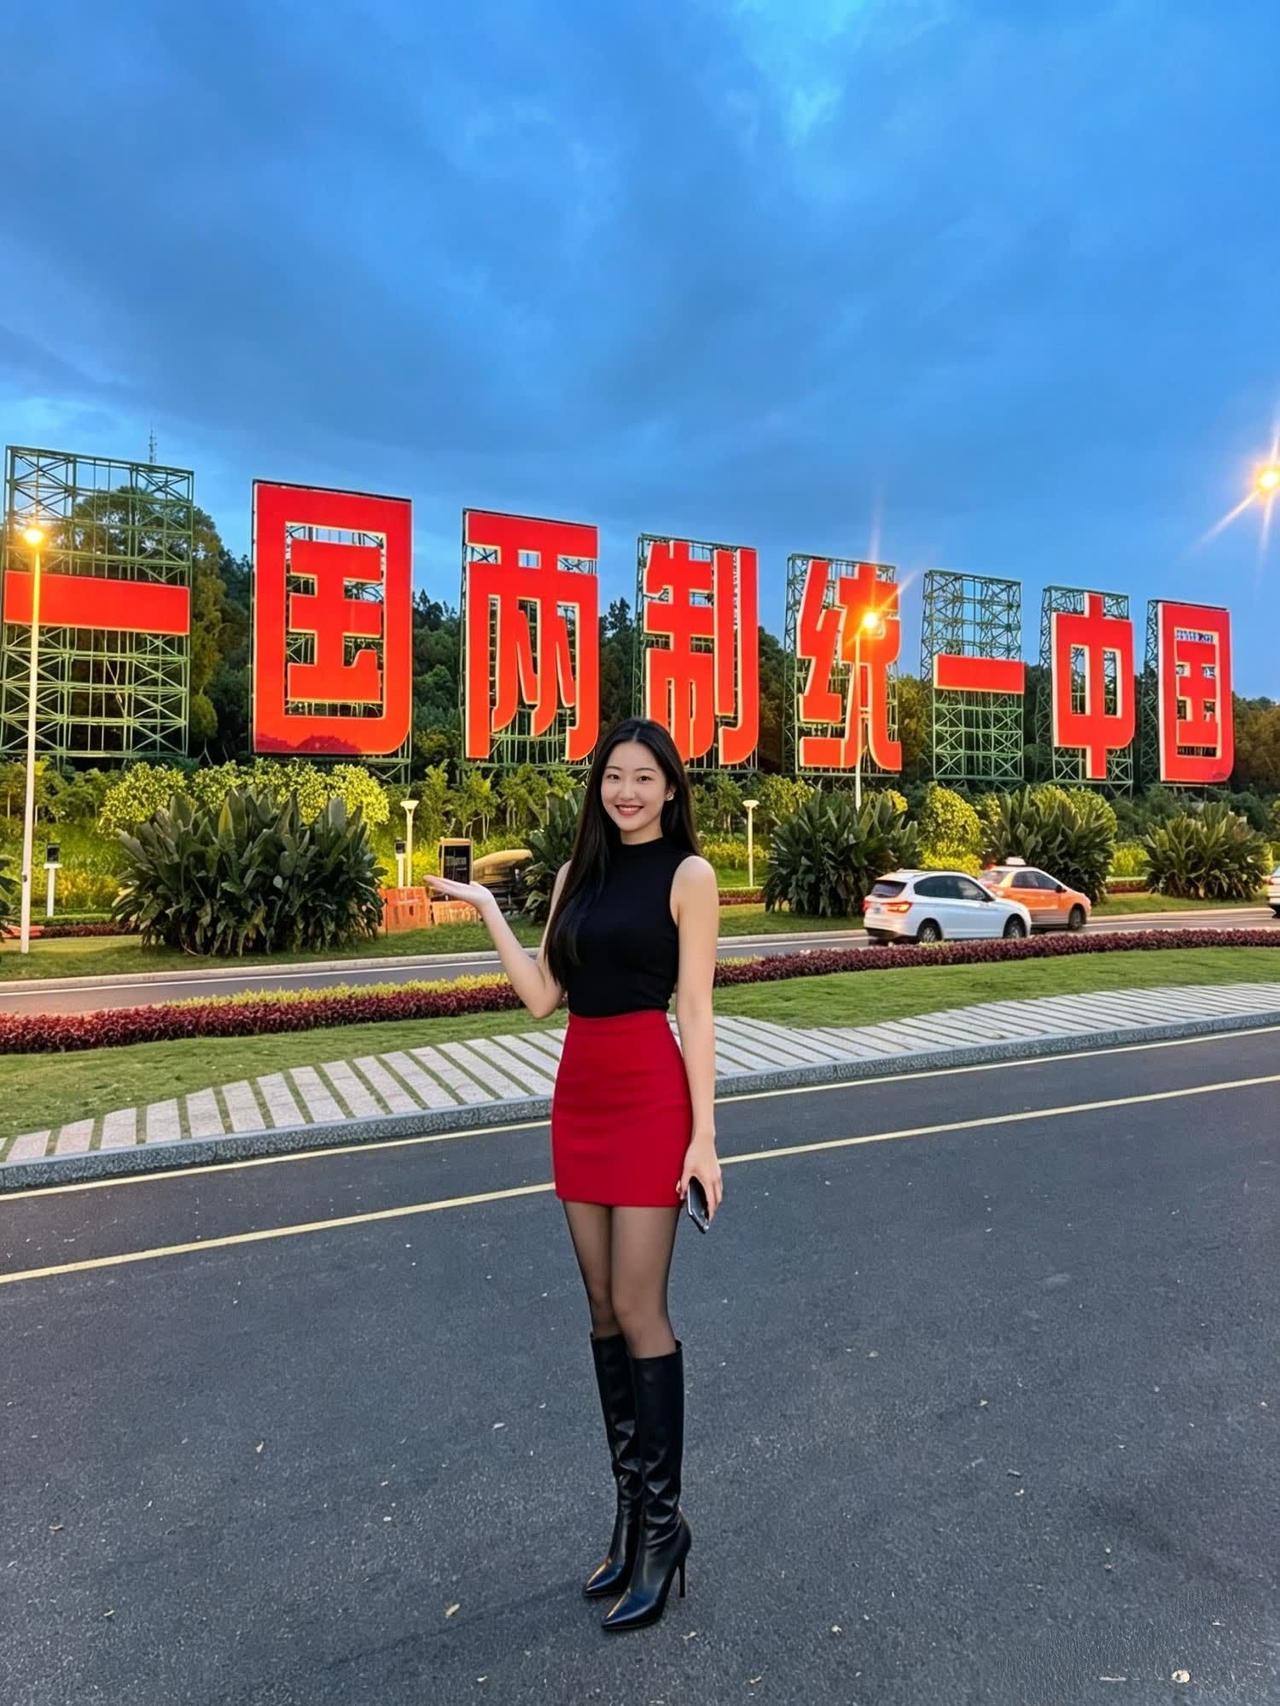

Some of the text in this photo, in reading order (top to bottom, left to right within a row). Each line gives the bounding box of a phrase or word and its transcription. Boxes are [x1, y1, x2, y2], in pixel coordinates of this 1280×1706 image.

[3, 480, 1234, 785] 一国两制统一中国
